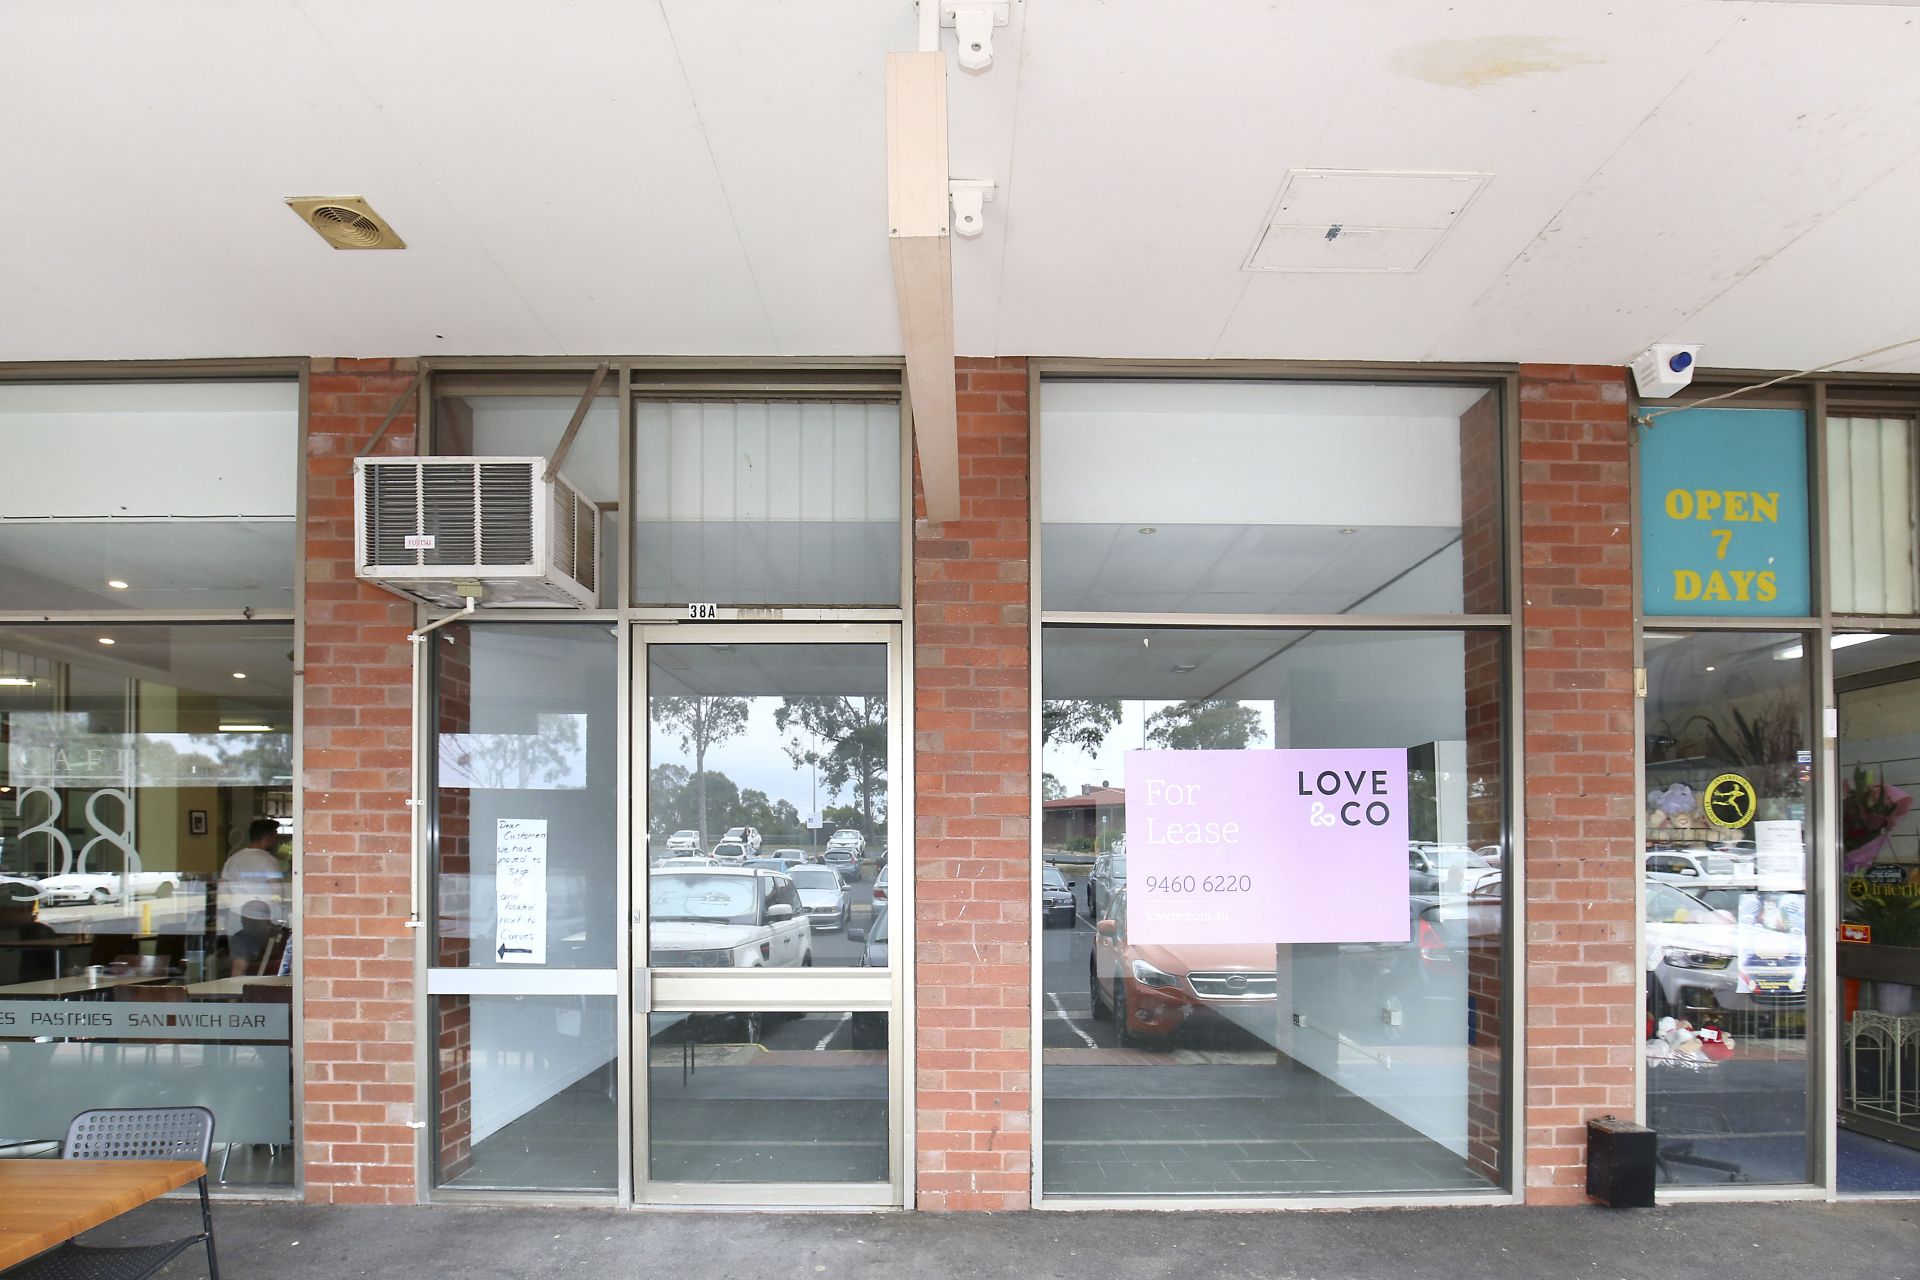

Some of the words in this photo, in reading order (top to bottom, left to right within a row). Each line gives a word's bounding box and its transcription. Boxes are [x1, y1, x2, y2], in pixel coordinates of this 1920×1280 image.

[1665, 489, 1780, 523] OPEN
[408, 539, 432, 547] FUJITSU
[1711, 529, 1732, 560] 7
[1673, 569, 1777, 601] DAYS
[690, 605, 715, 618] 38A
[1145, 779, 1201, 806] For
[1298, 770, 1388, 796] LOVE
[1310, 801, 1336, 827] &
[1340, 801, 1390, 826] CO
[12, 785, 142, 901] 38
[1146, 817, 1240, 844] Lease
[1146, 875, 1196, 893] 9460
[1202, 875, 1252, 893] 6220
[31, 1012, 113, 1026] PASTRIES
[228, 1015, 266, 1028] BAR
